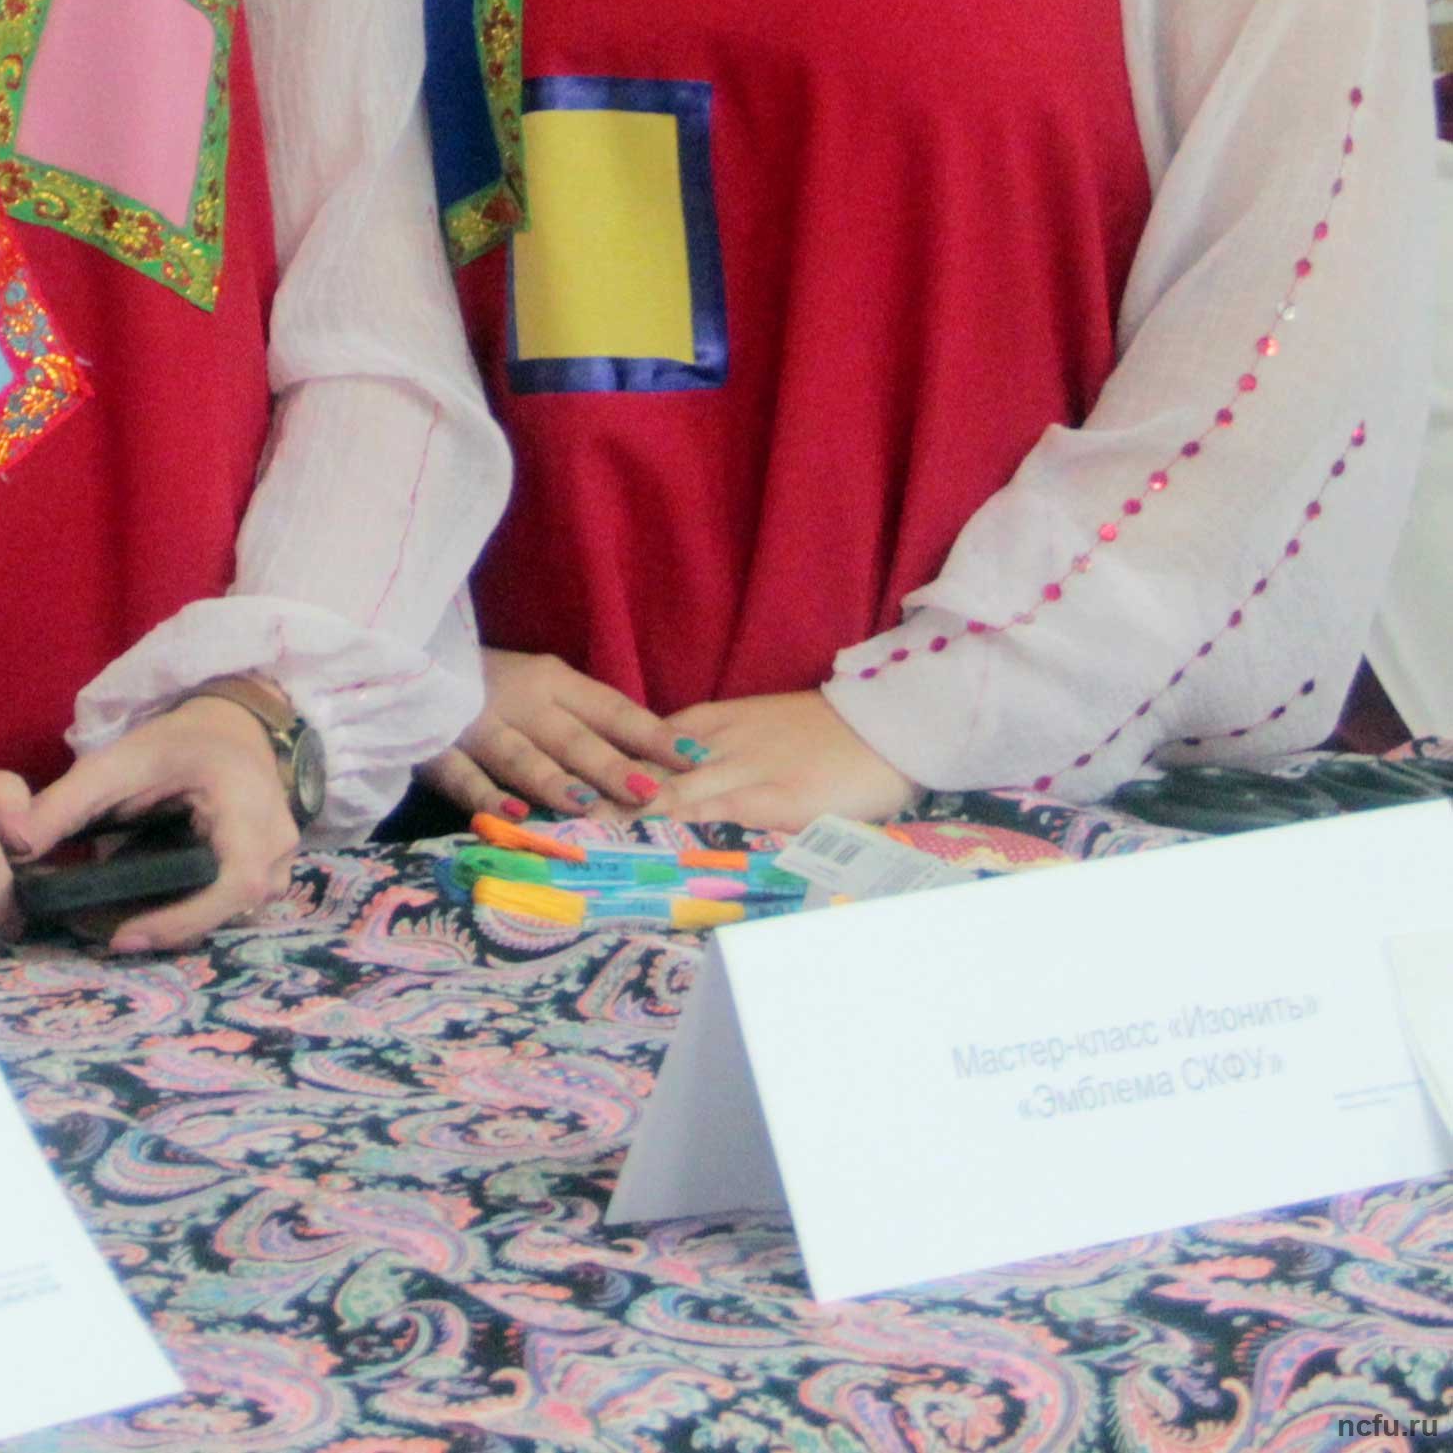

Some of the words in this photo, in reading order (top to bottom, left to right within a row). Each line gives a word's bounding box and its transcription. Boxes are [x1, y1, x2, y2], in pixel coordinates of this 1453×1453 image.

[952, 1020, 1159, 1079] Мастер-класс
[1168, 994, 1320, 1038] «Изонить»
[1018, 1070, 1175, 1118] «Эмблема
[1181, 1046, 1286, 1091] СКФУ»
